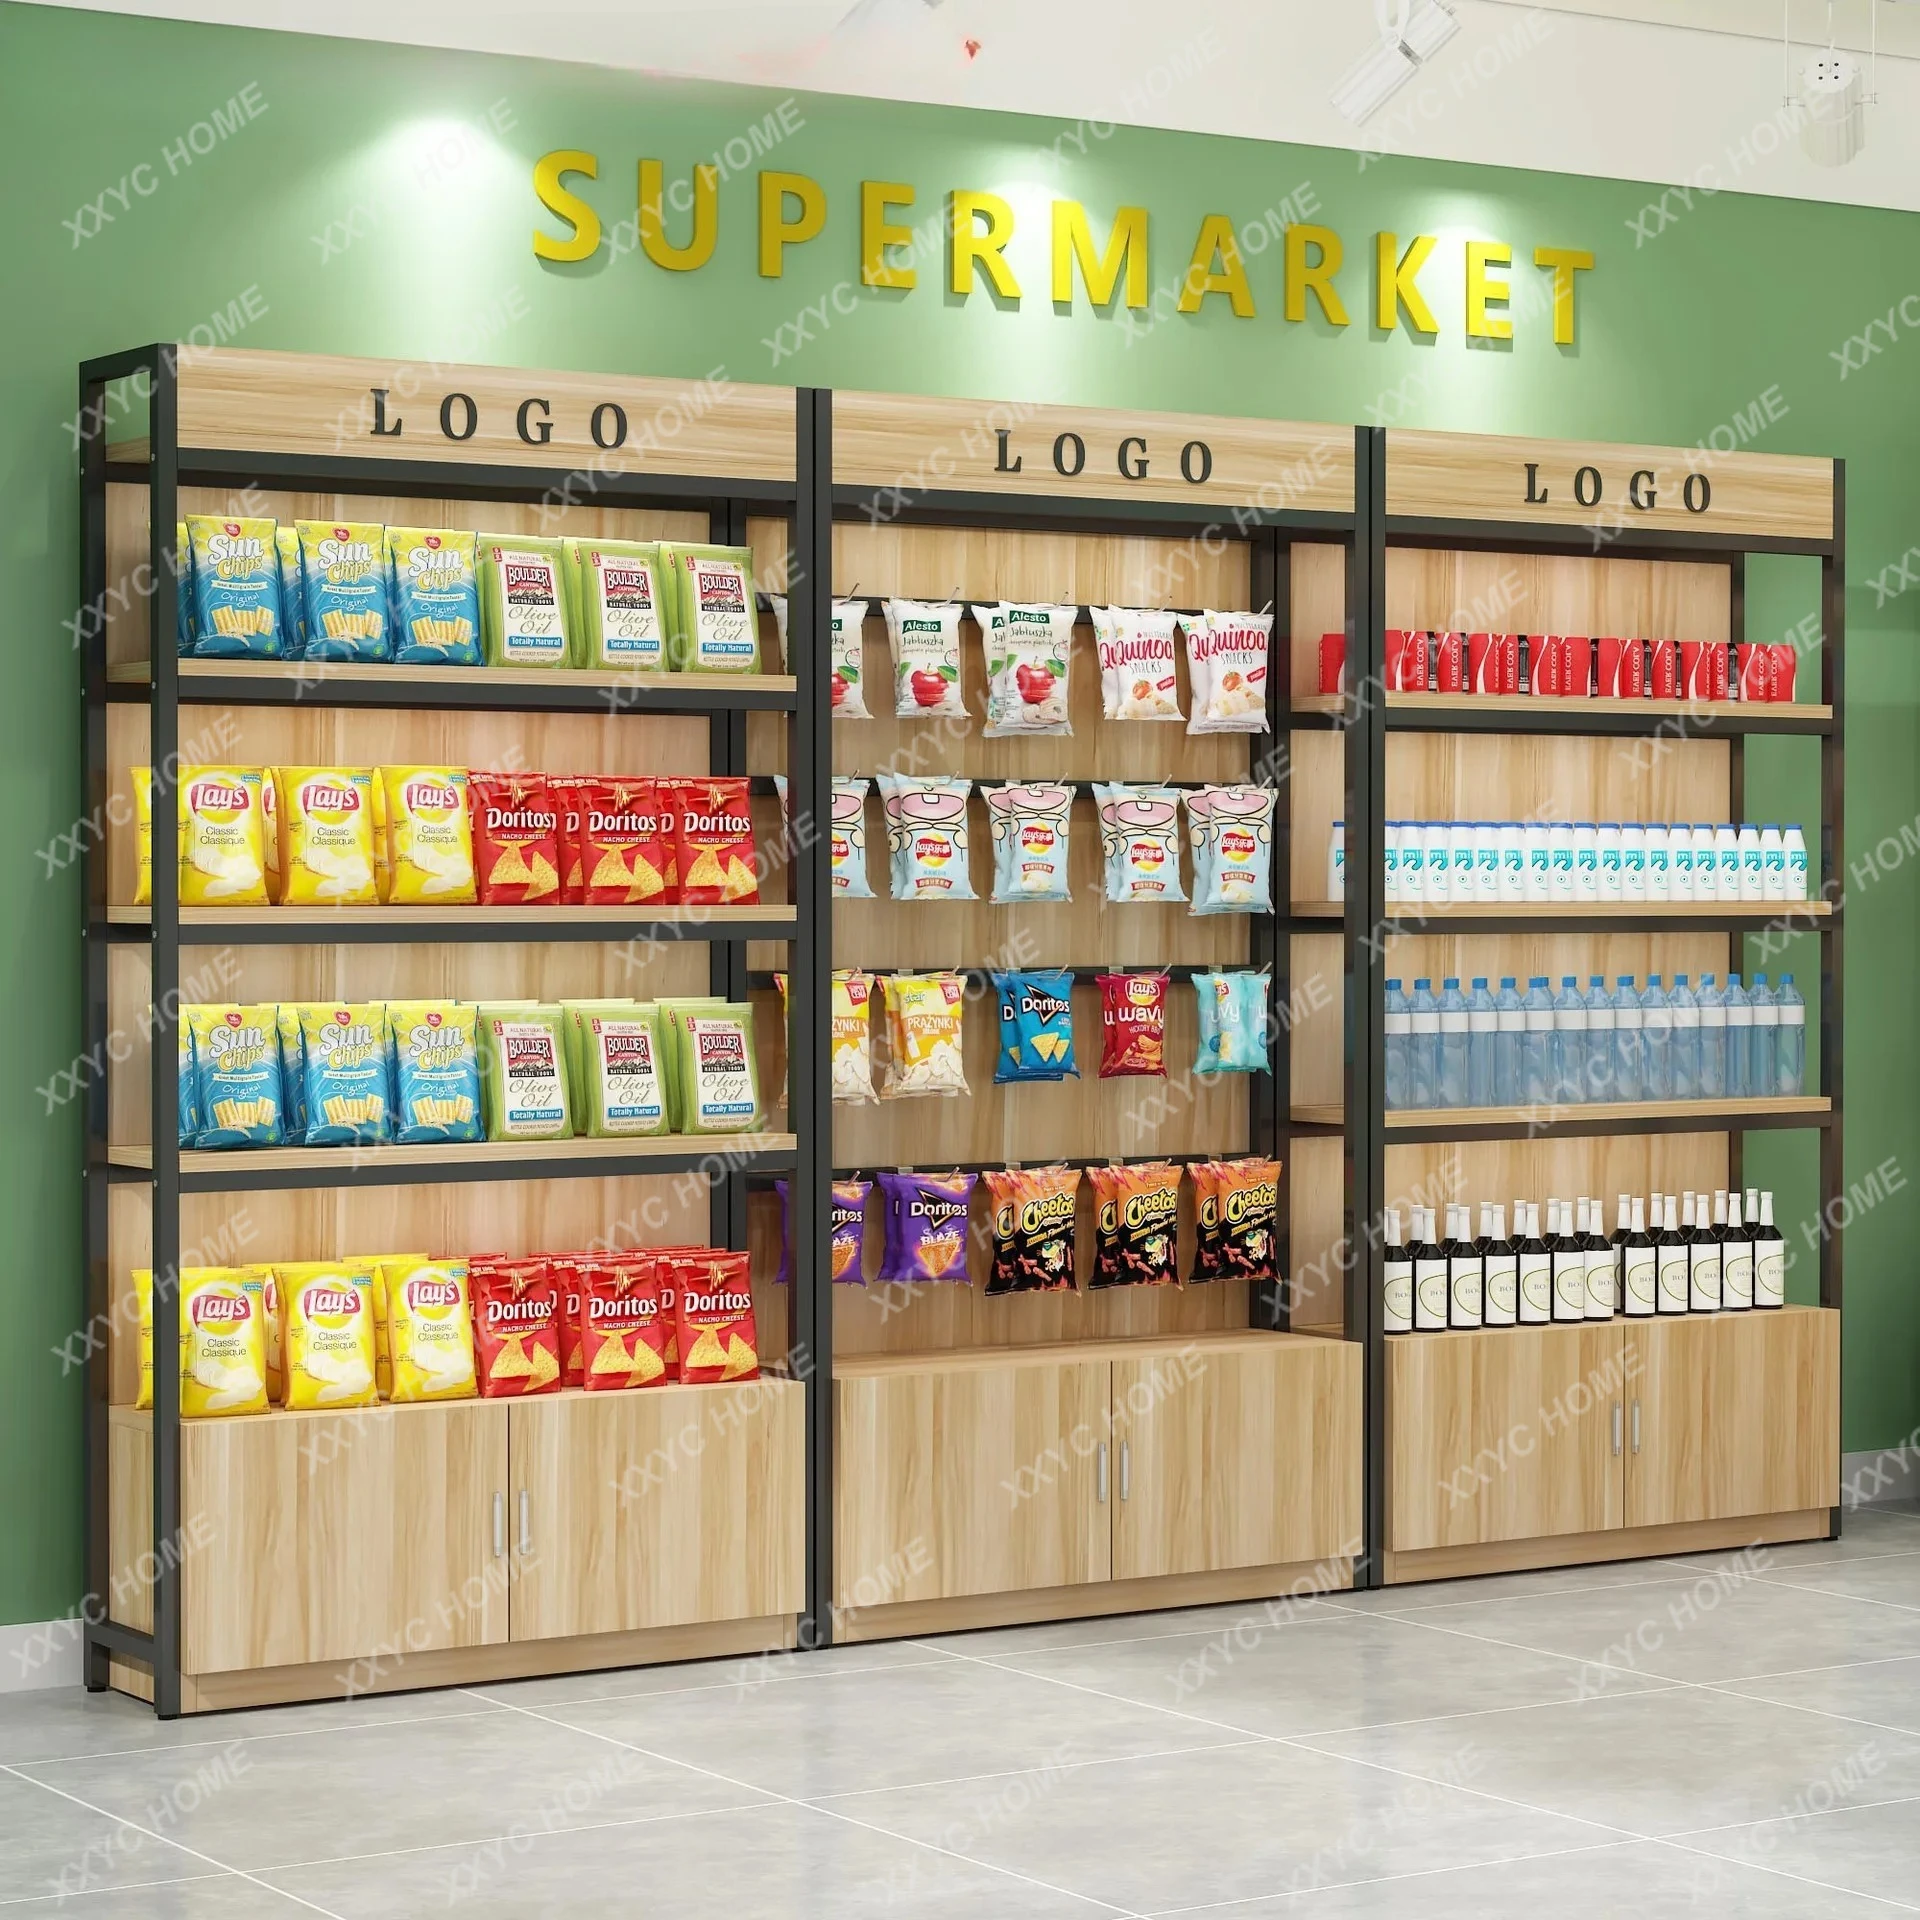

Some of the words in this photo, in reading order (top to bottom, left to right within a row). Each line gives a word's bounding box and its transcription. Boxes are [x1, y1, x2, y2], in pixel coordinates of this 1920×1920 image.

[533, 149, 1594, 346] SUPERMARKET
[370, 387, 628, 449] LOGO
[994, 428, 1212, 484] LOGO
[1524, 462, 1711, 514] LOGO
[208, 534, 264, 566] Sun
[318, 539, 373, 570] Sun
[408, 548, 464, 577] Sun
[507, 566, 550, 587] BOULDER
[607, 569, 648, 591] BOULDER
[701, 573, 741, 595] BOULDER
[221, 592, 260, 608] Original
[331, 595, 368, 611] Original
[420, 603, 458, 618] Original
[508, 605, 559, 621] Olive
[607, 609, 654, 625] Olive
[1011, 612, 1047, 622] Alesto
[520, 620, 552, 635] Oil
[702, 613, 748, 628] Olive
[905, 621, 938, 631] Alesto
[618, 624, 648, 638] Oil
[712, 628, 742, 641] Oil
[1010, 625, 1052, 638] Jabłuszka
[511, 637, 534, 647] Totally
[535, 637, 561, 647] Natural
[610, 640, 633, 650] Totally
[634, 641, 659, 650] Natural
[705, 643, 728, 653] Totally
[728, 644, 752, 653] Natural
[901, 635, 944, 647] Jabłuszka
[1208, 629, 1266, 655] Quinoa
[1116, 639, 1174, 666] Quinoa
[1220, 651, 1253, 665] SNACKS
[1130, 661, 1162, 674] SNACKS
[486, 806, 551, 830] Doritos
[588, 809, 658, 833] Doritos
[683, 810, 751, 833] Doritos
[206, 826, 238, 836] Classic
[317, 827, 350, 836] Classic
[422, 825, 451, 834] Classic
[200, 836, 245, 847] Classique
[312, 836, 356, 847] Classique
[417, 834, 458, 845] Classique
[1129, 982, 1159, 996] Lay's
[905, 992, 926, 1003] star
[1021, 997, 1070, 1014] Doritos
[908, 1014, 954, 1030] PRAŻYNKI
[1118, 1004, 1164, 1029] wavy
[209, 1025, 266, 1058] Sun
[319, 1024, 374, 1057] Sun
[410, 1024, 465, 1057] Sun
[607, 1036, 649, 1056] BOULDER
[701, 1035, 742, 1054] BOULDER
[509, 1039, 551, 1059] BOULDER
[332, 1080, 370, 1096] Original
[509, 1078, 558, 1093] Olive
[607, 1076, 655, 1091] Olive
[702, 1074, 749, 1088] Olive
[222, 1083, 261, 1099] Original
[421, 1081, 460, 1097] Original
[713, 1087, 743, 1101] Oil
[520, 1092, 552, 1107] Oil
[619, 1090, 649, 1105] Oil
[512, 1111, 535, 1121] Totally
[536, 1109, 562, 1119] Natural
[610, 1108, 633, 1118] Totally
[634, 1107, 659, 1116] Natural
[705, 1105, 728, 1114] Totally
[728, 1104, 752, 1113] Natural
[911, 1201, 968, 1217] Doritos
[1125, 1189, 1177, 1231] Cheetos
[1226, 1184, 1276, 1225] Cheetos
[1021, 1194, 1075, 1234] Cheetos
[919, 1230, 960, 1246] BLAZE
[589, 1294, 658, 1318] Doritos
[683, 1289, 751, 1314] Doritos
[486, 1297, 553, 1322] Doritos
[423, 1323, 452, 1332] Classic
[525, 1323, 547, 1331] CHEESE
[627, 1319, 651, 1327] CHEESE
[207, 1338, 240, 1348] Classic
[318, 1332, 350, 1342] Classic
[417, 1331, 458, 1342] Classique
[201, 1348, 247, 1358] Classique
[313, 1340, 357, 1351] Classique
